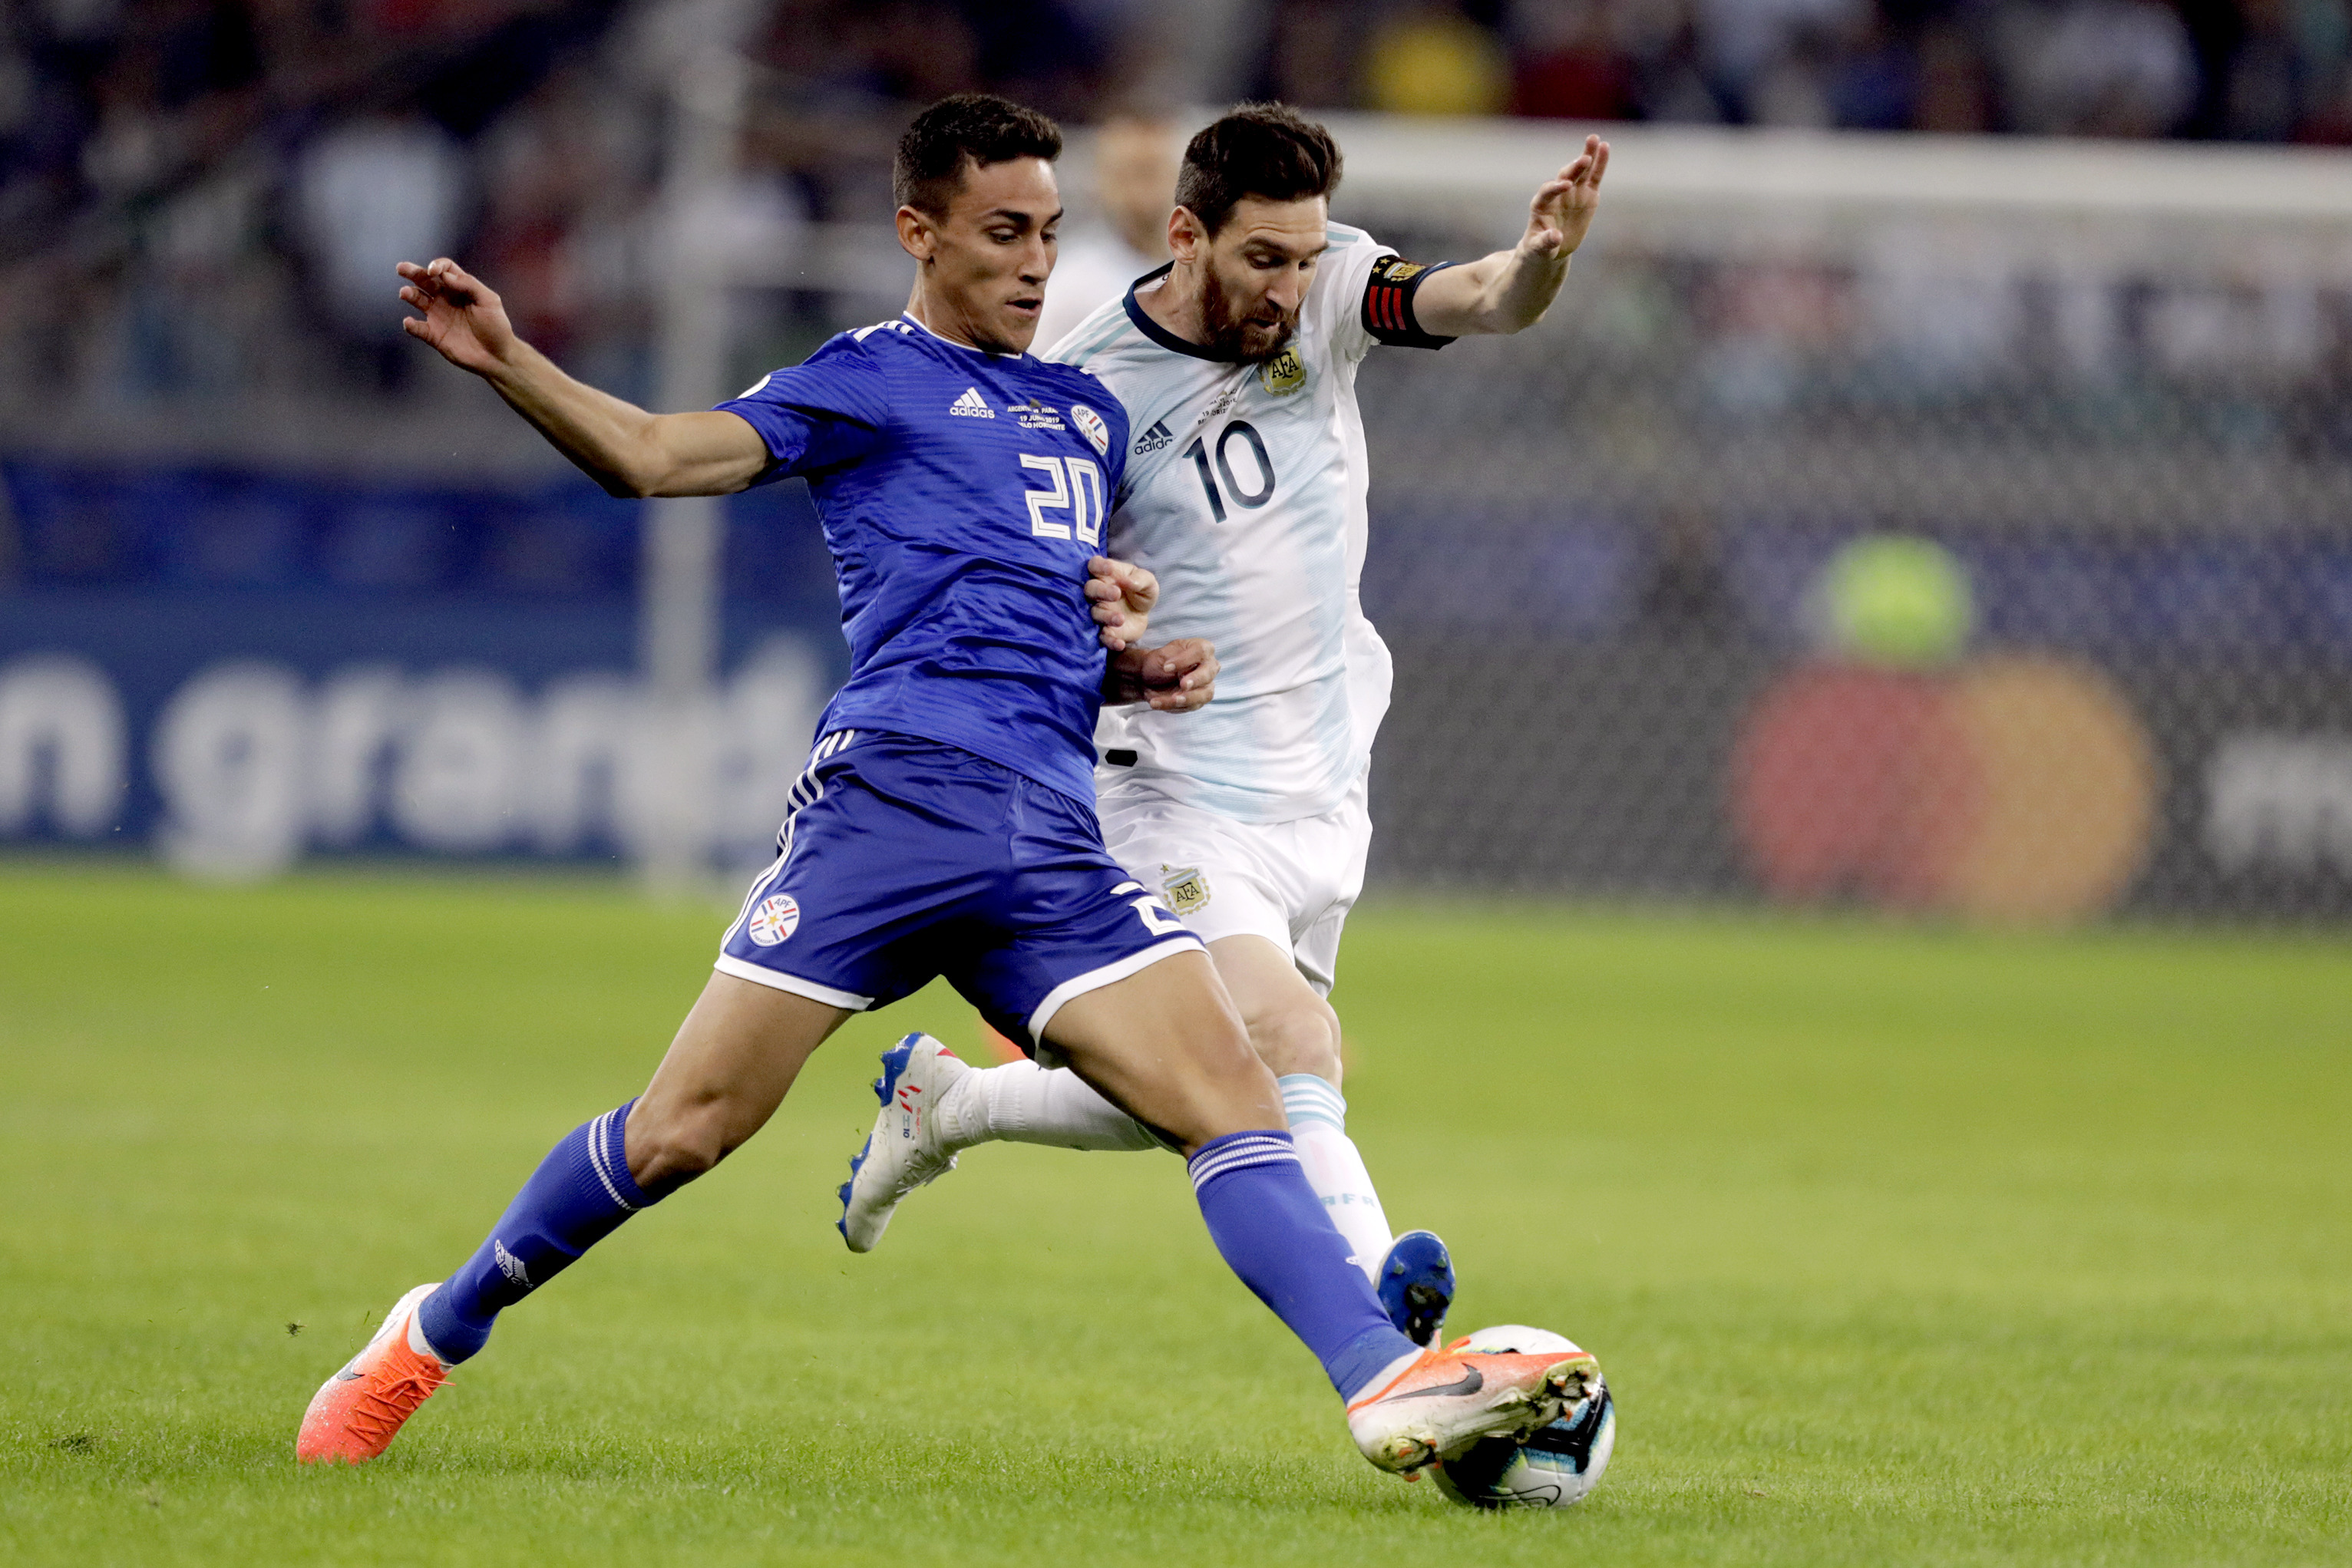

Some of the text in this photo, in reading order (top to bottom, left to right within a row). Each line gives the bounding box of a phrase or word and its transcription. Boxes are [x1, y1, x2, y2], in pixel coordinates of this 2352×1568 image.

[1272, 351, 1299, 378] AFA
[950, 406, 996, 418] adidas
[1076, 408, 1089, 418] APF
[1182, 420, 1276, 523] 10
[1019, 454, 1103, 548] 20
[1175, 882, 1200, 902] AFA
[774, 898, 791, 908] APF
